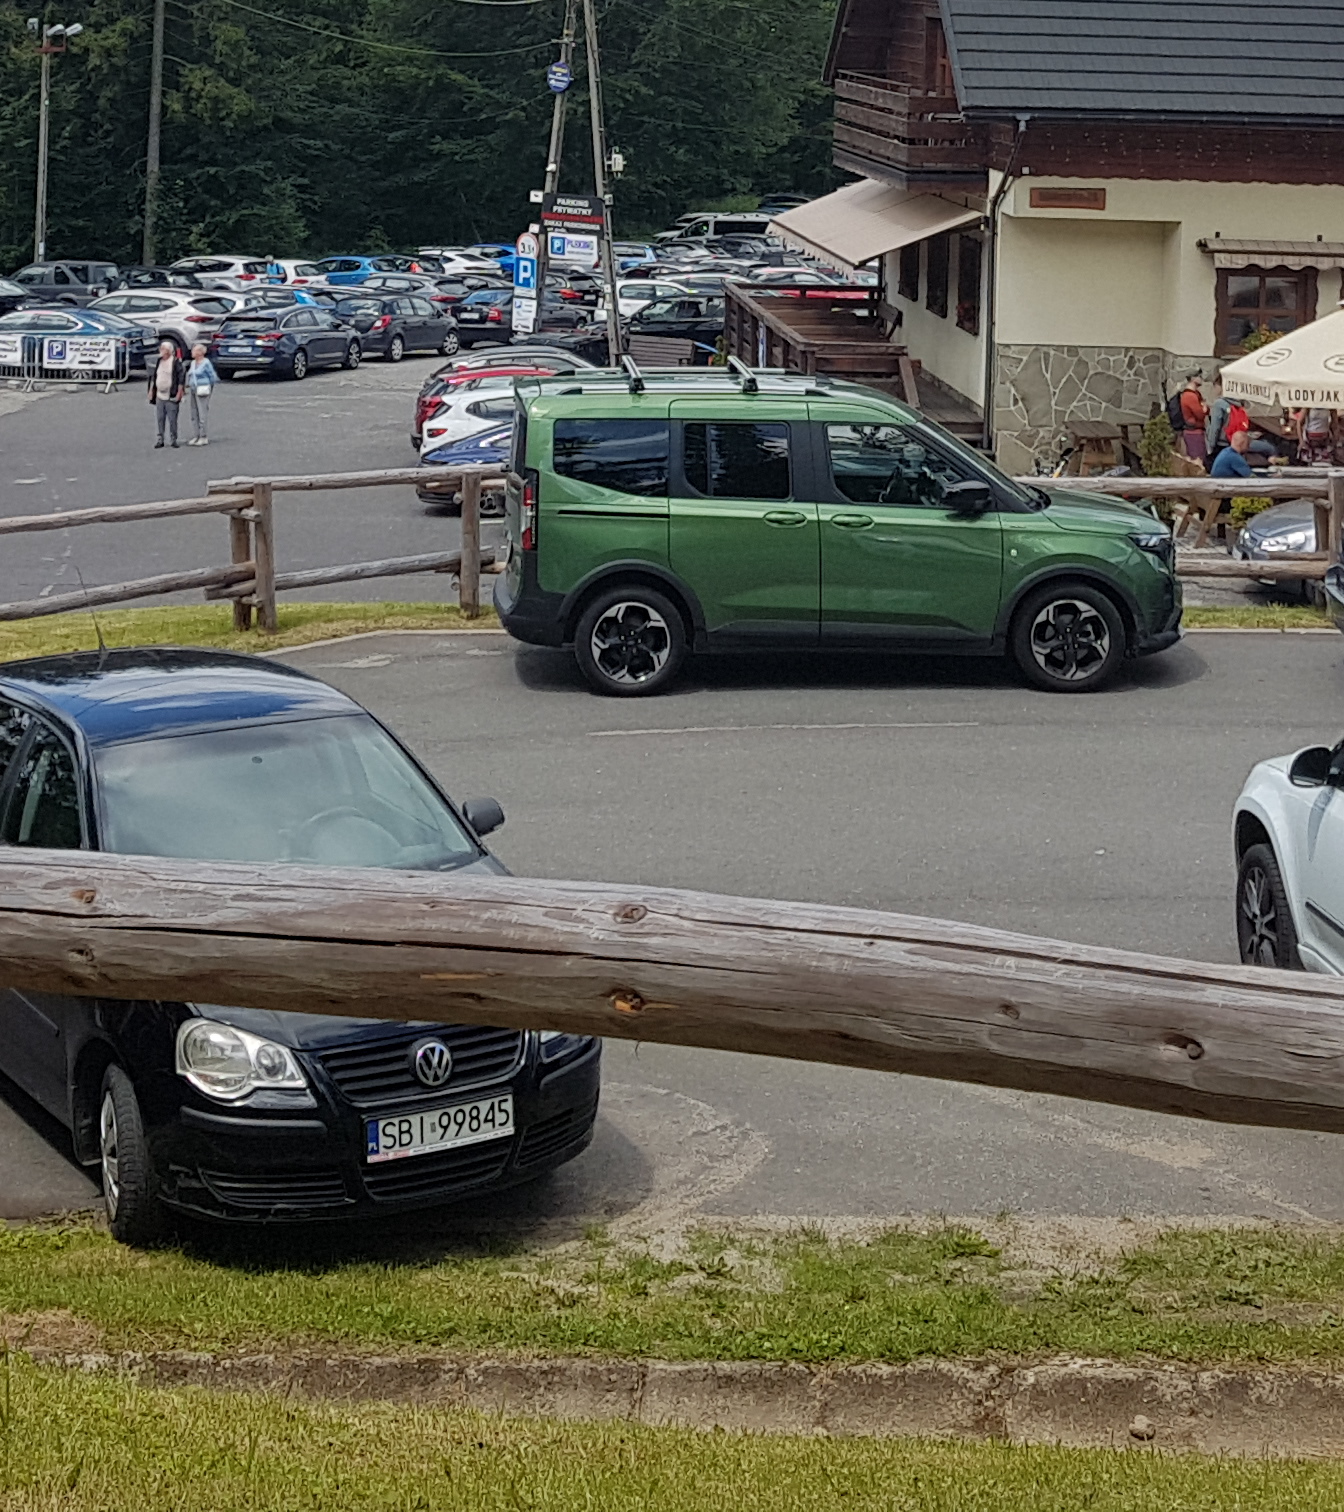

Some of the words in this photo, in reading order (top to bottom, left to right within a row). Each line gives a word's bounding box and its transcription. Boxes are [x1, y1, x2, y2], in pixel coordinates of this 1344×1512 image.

[518, 260, 532, 285] P
[1288, 389, 1316, 402] LODY
[1319, 390, 1340, 403] JAK
[381, 1116, 424, 1149] SBI
[438, 1098, 510, 1140] 99845
